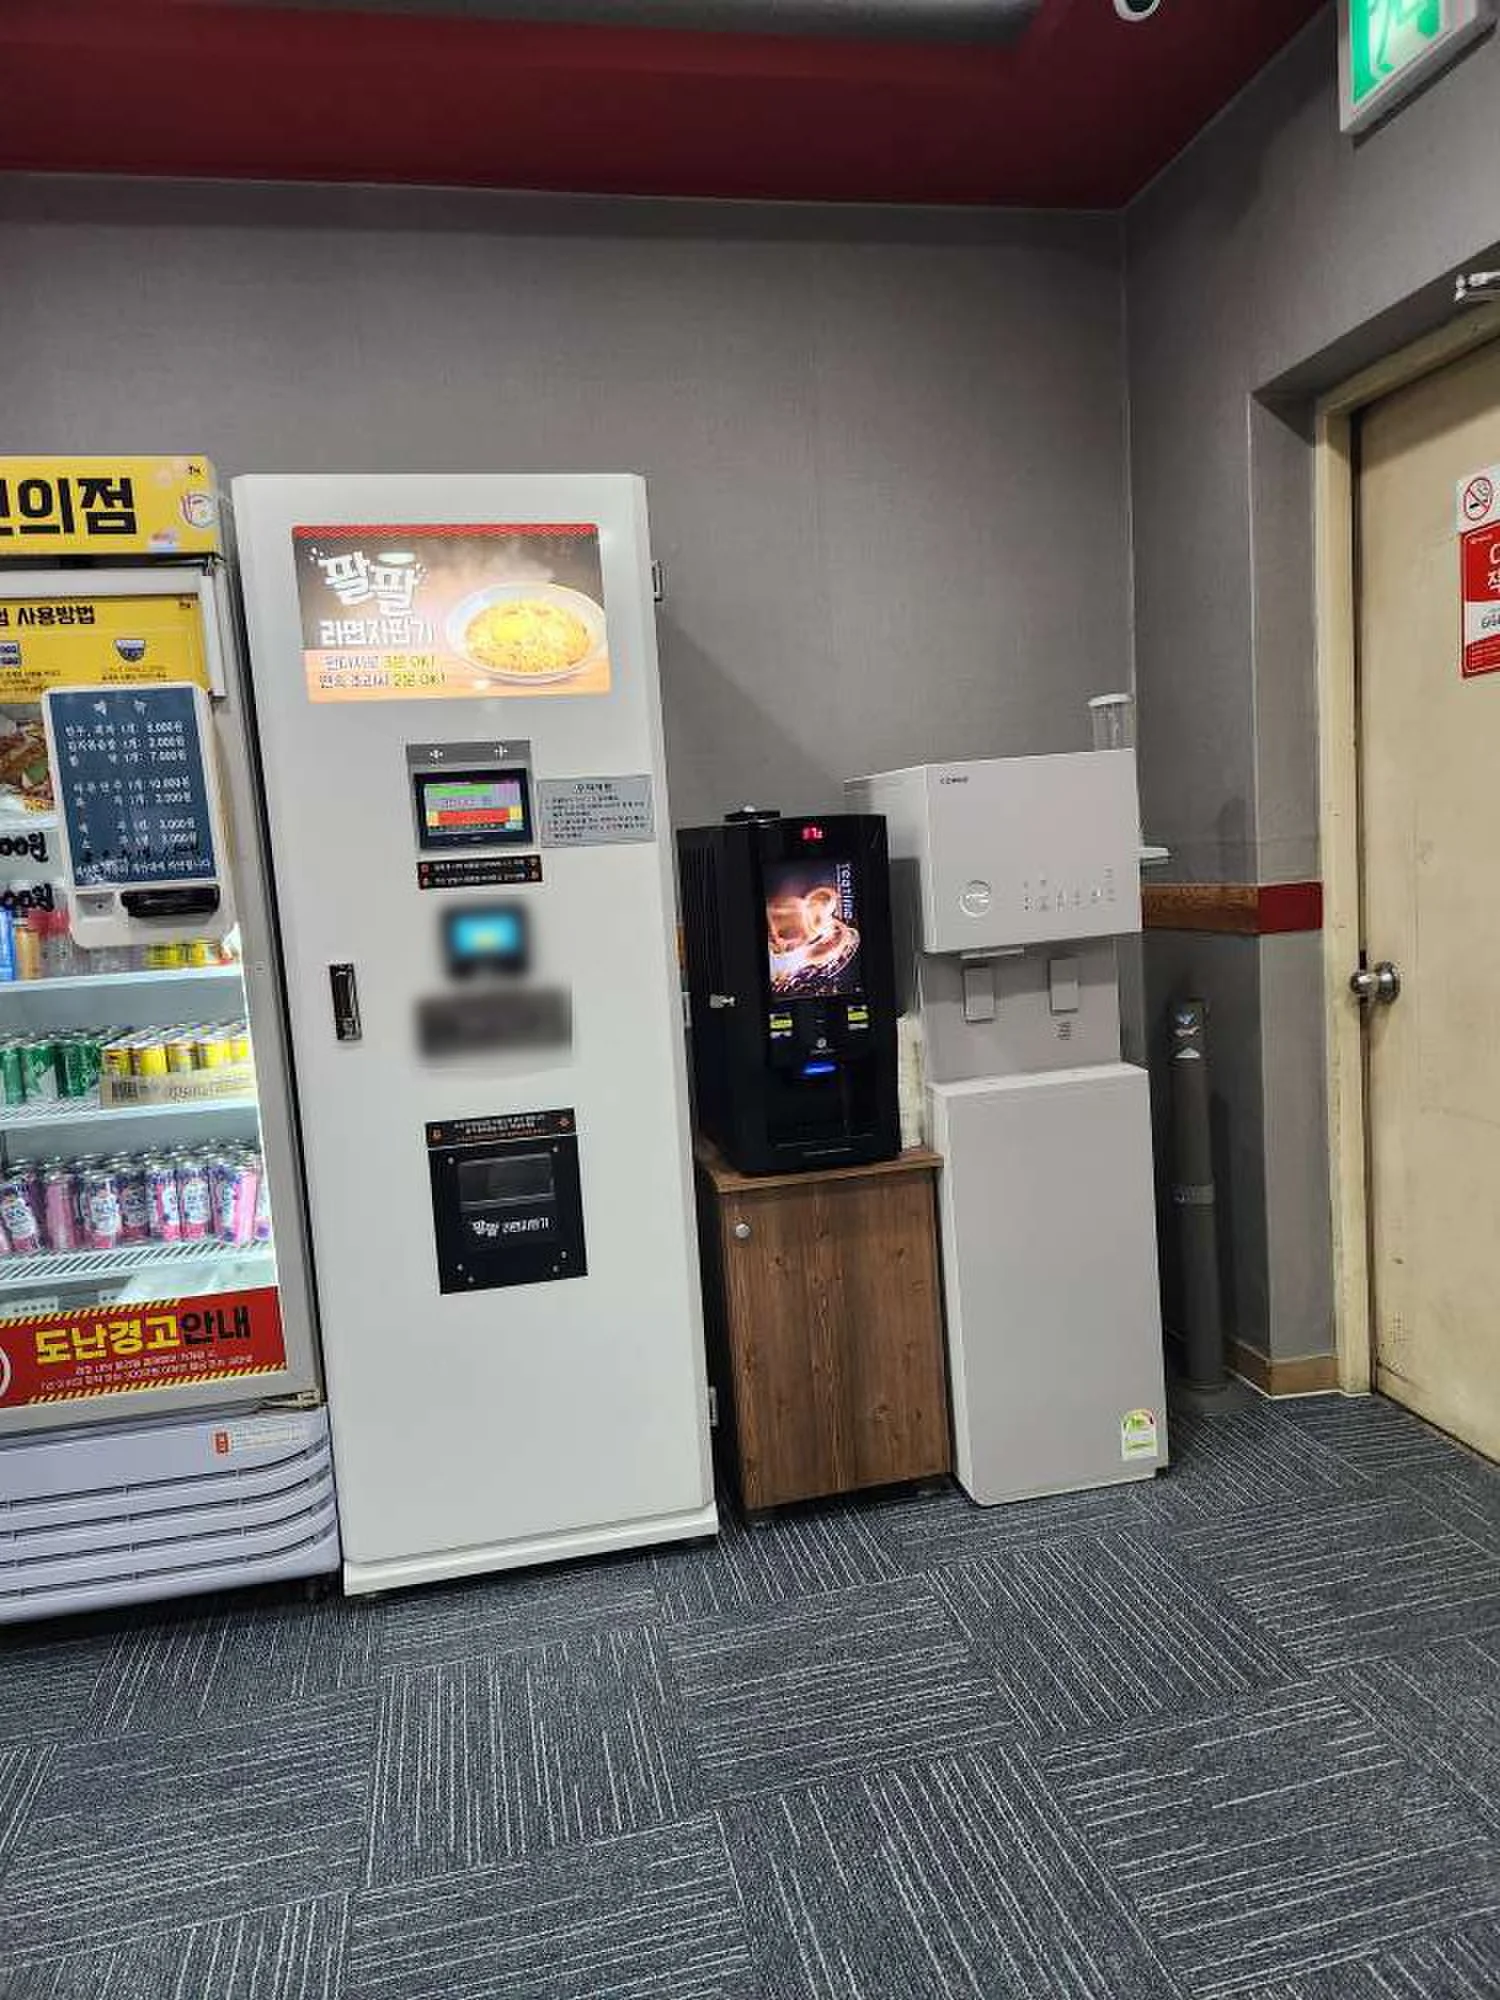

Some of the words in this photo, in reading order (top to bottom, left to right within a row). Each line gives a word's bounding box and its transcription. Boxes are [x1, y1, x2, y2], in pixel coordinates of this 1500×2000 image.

[18, 606, 95, 626] 사용방법
[319, 618, 435, 645] 라면자판기
[35, 1306, 251, 1364] 도난경고안내
